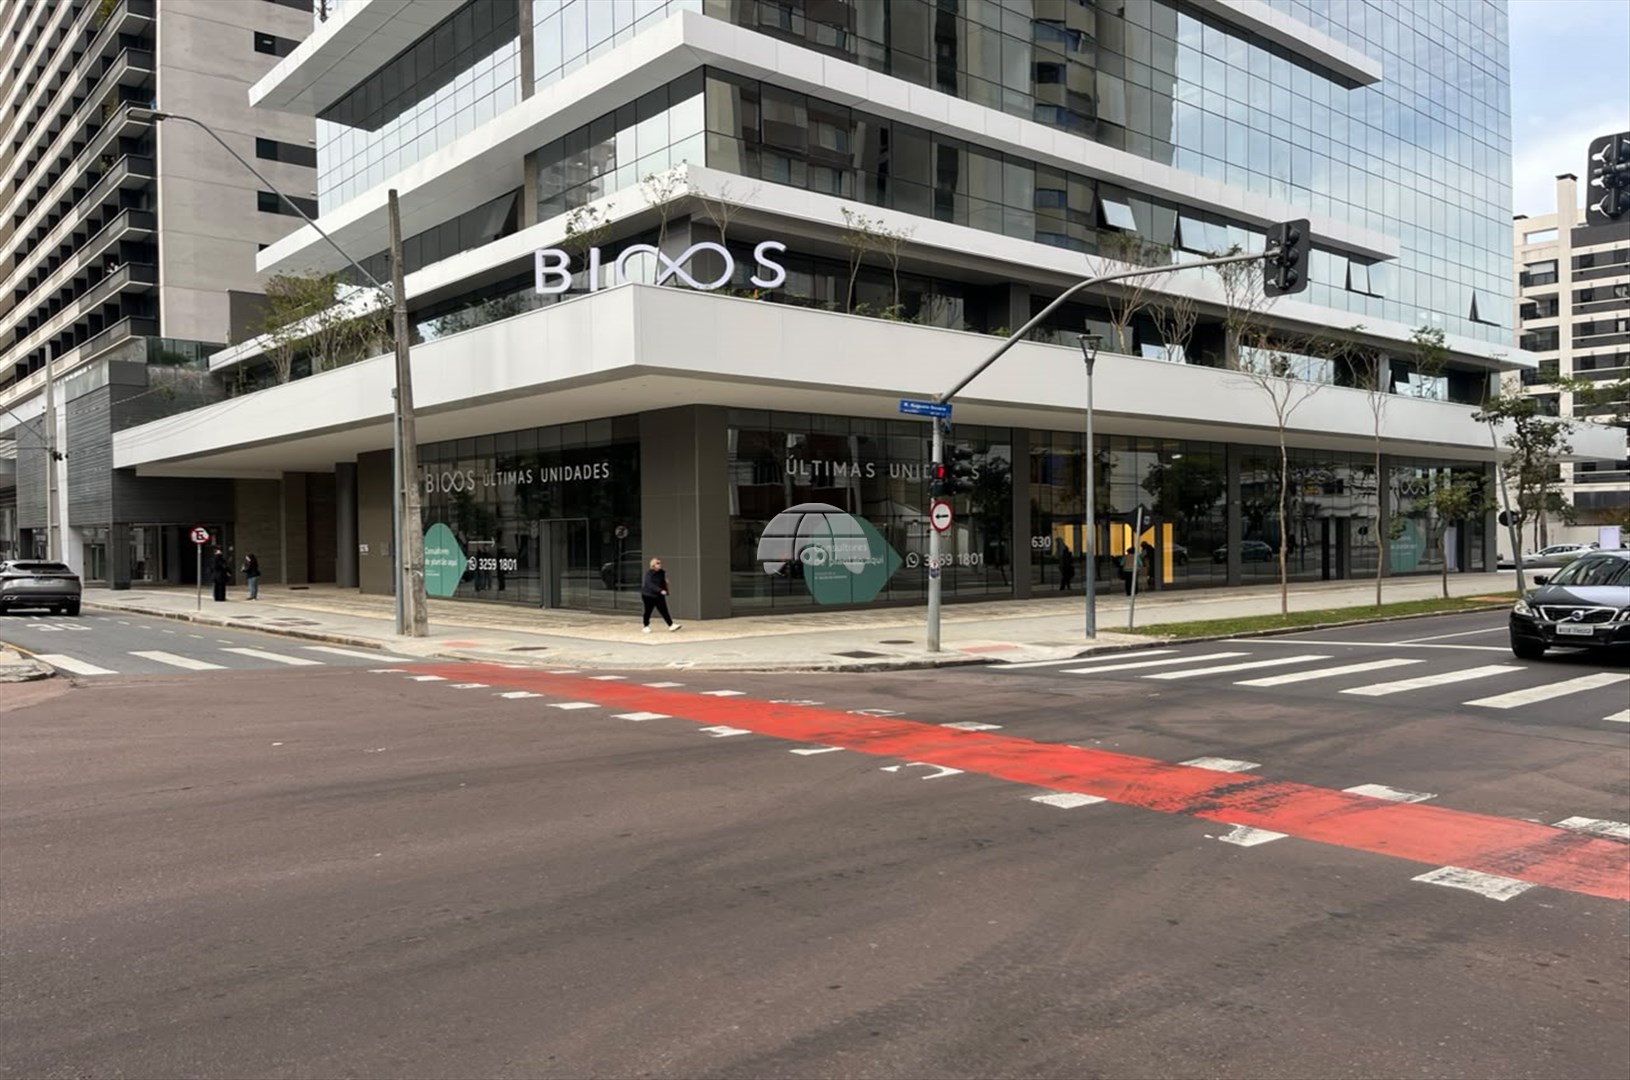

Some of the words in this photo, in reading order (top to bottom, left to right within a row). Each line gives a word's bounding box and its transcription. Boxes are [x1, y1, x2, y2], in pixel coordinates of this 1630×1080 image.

[786, 454, 875, 478] ÚLTIMAS
[482, 468, 533, 487] ÚLTIMAS
[540, 462, 610, 482] UNIDADES
[1031, 535, 1051, 548] 630
[478, 558, 497, 570] 3259
[499, 558, 517, 571] 1801
[923, 553, 953, 567] 359
[957, 552, 984, 566] 1801
